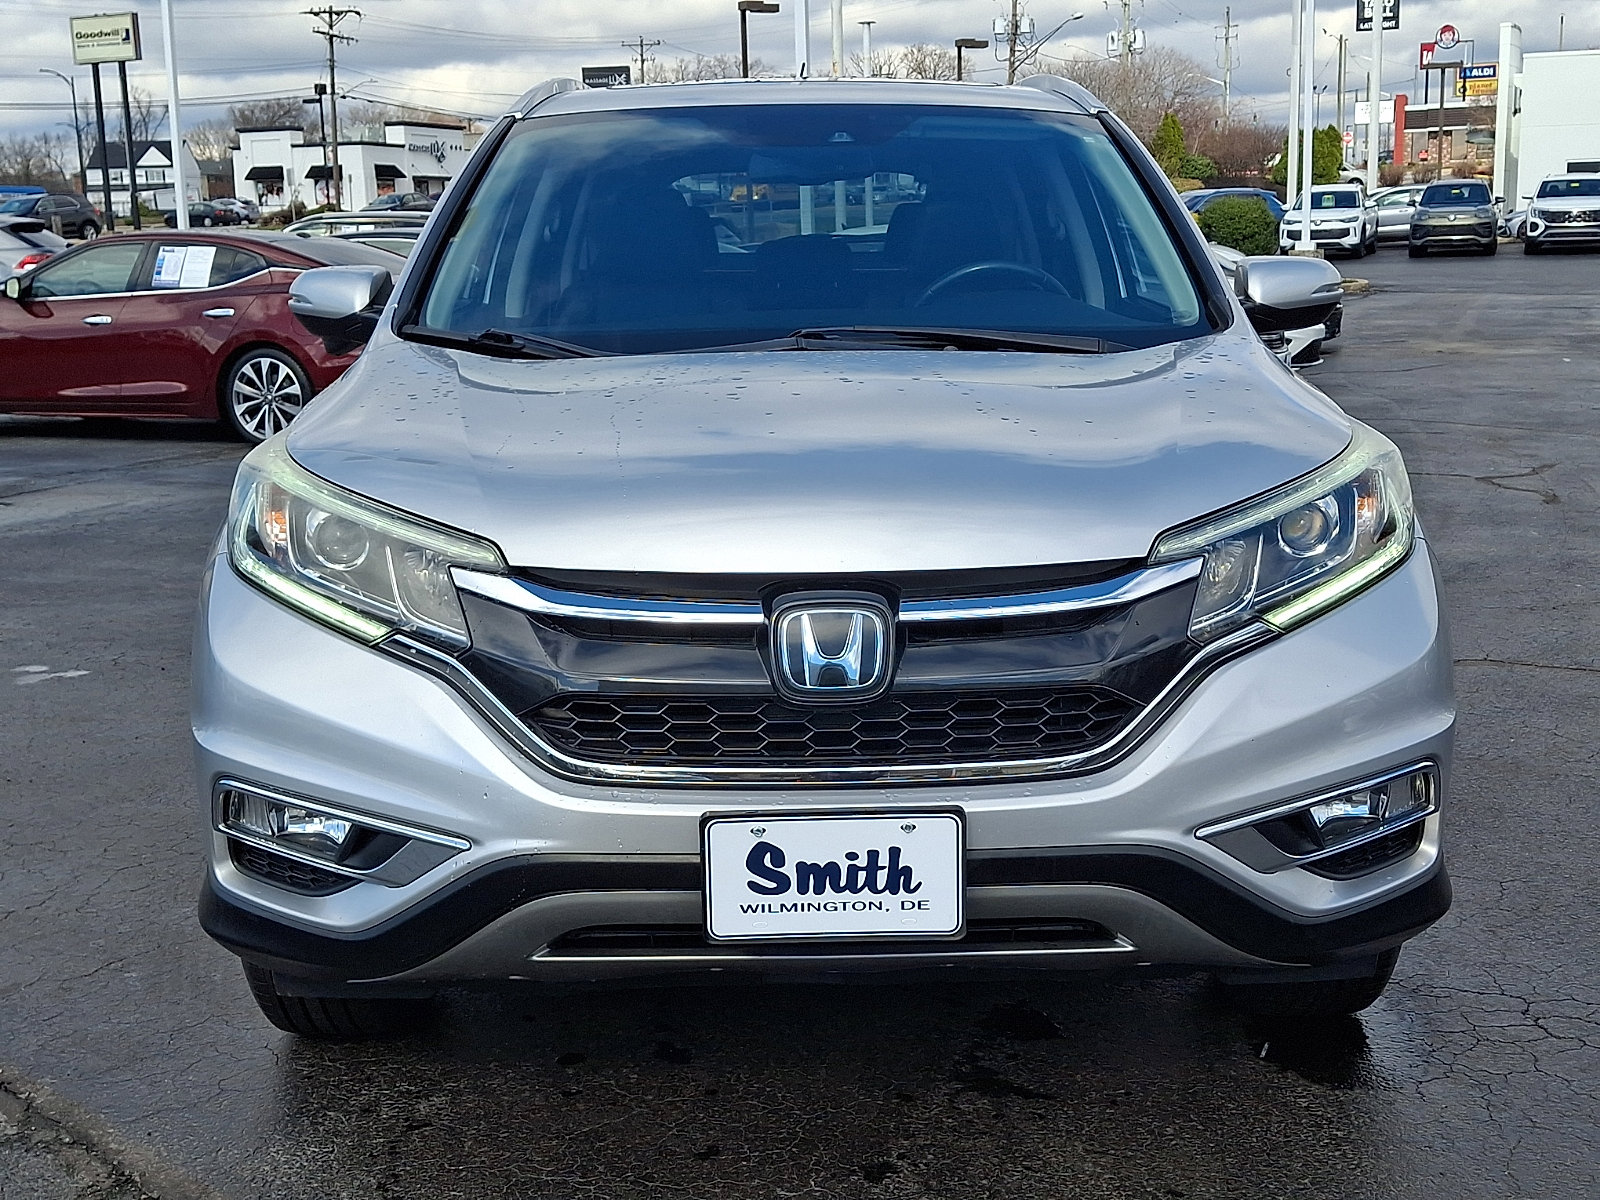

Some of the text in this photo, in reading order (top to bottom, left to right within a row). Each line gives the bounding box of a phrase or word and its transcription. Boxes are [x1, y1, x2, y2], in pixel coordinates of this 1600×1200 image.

[75, 28, 120, 40] Goodwill
[1471, 67, 1494, 77] ALDI
[745, 841, 923, 896] Smith
[739, 899, 931, 914] WILMINGTON, DE
